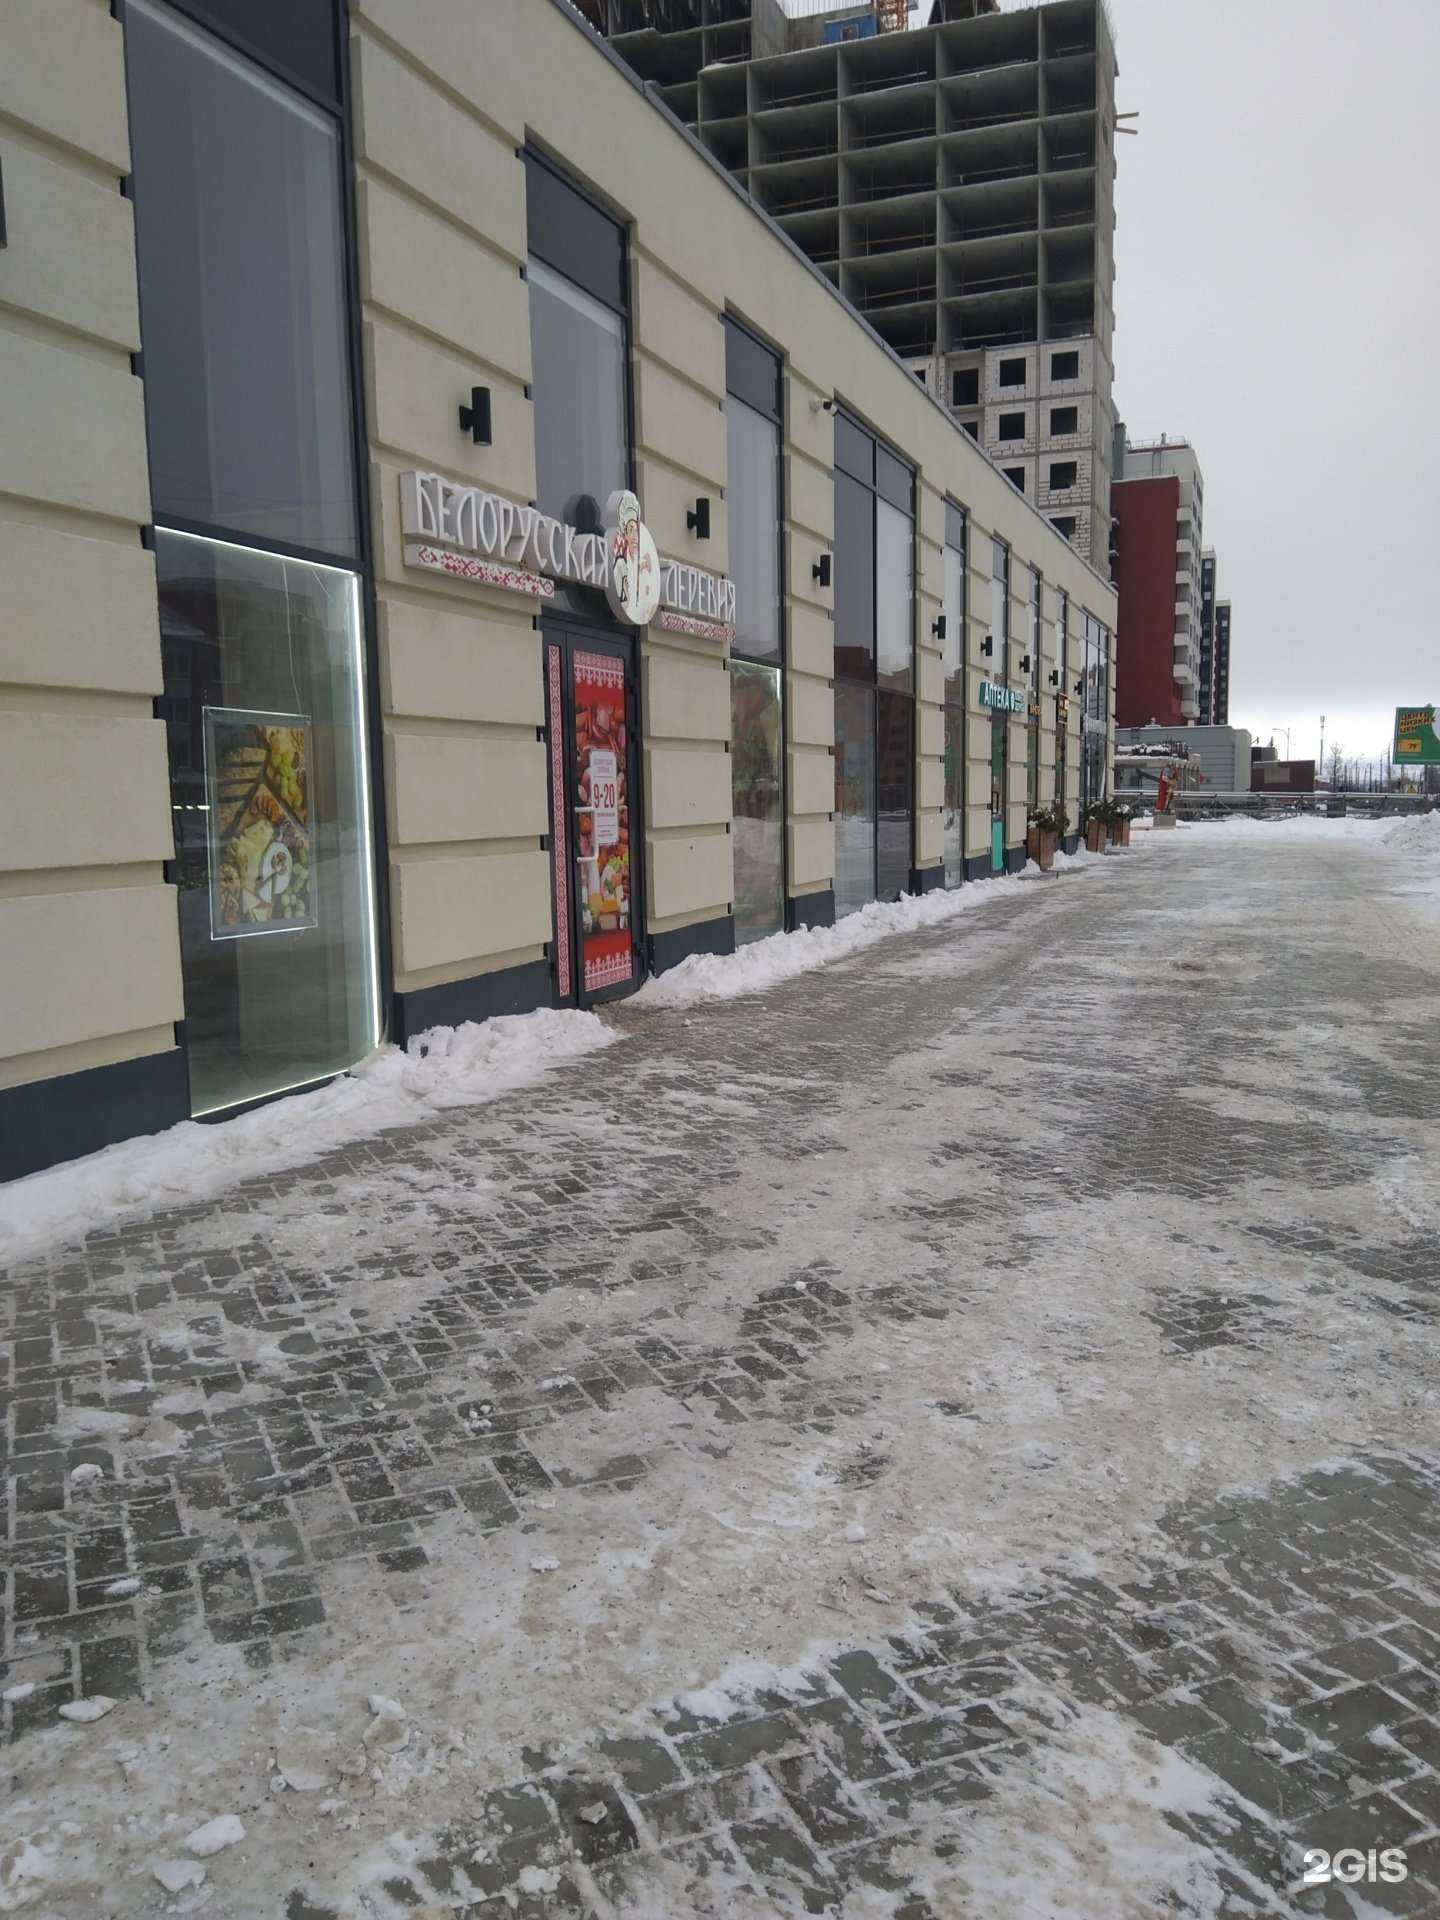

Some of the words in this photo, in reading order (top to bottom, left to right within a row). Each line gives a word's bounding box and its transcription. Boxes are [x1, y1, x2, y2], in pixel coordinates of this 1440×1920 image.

[413, 471, 609, 588] БЕЛОРУССКАЯ
[664, 560, 736, 624] ДЕРЕВНЯ
[983, 682, 1010, 710] АПТЕКА
[593, 783, 615, 808] 9-20
